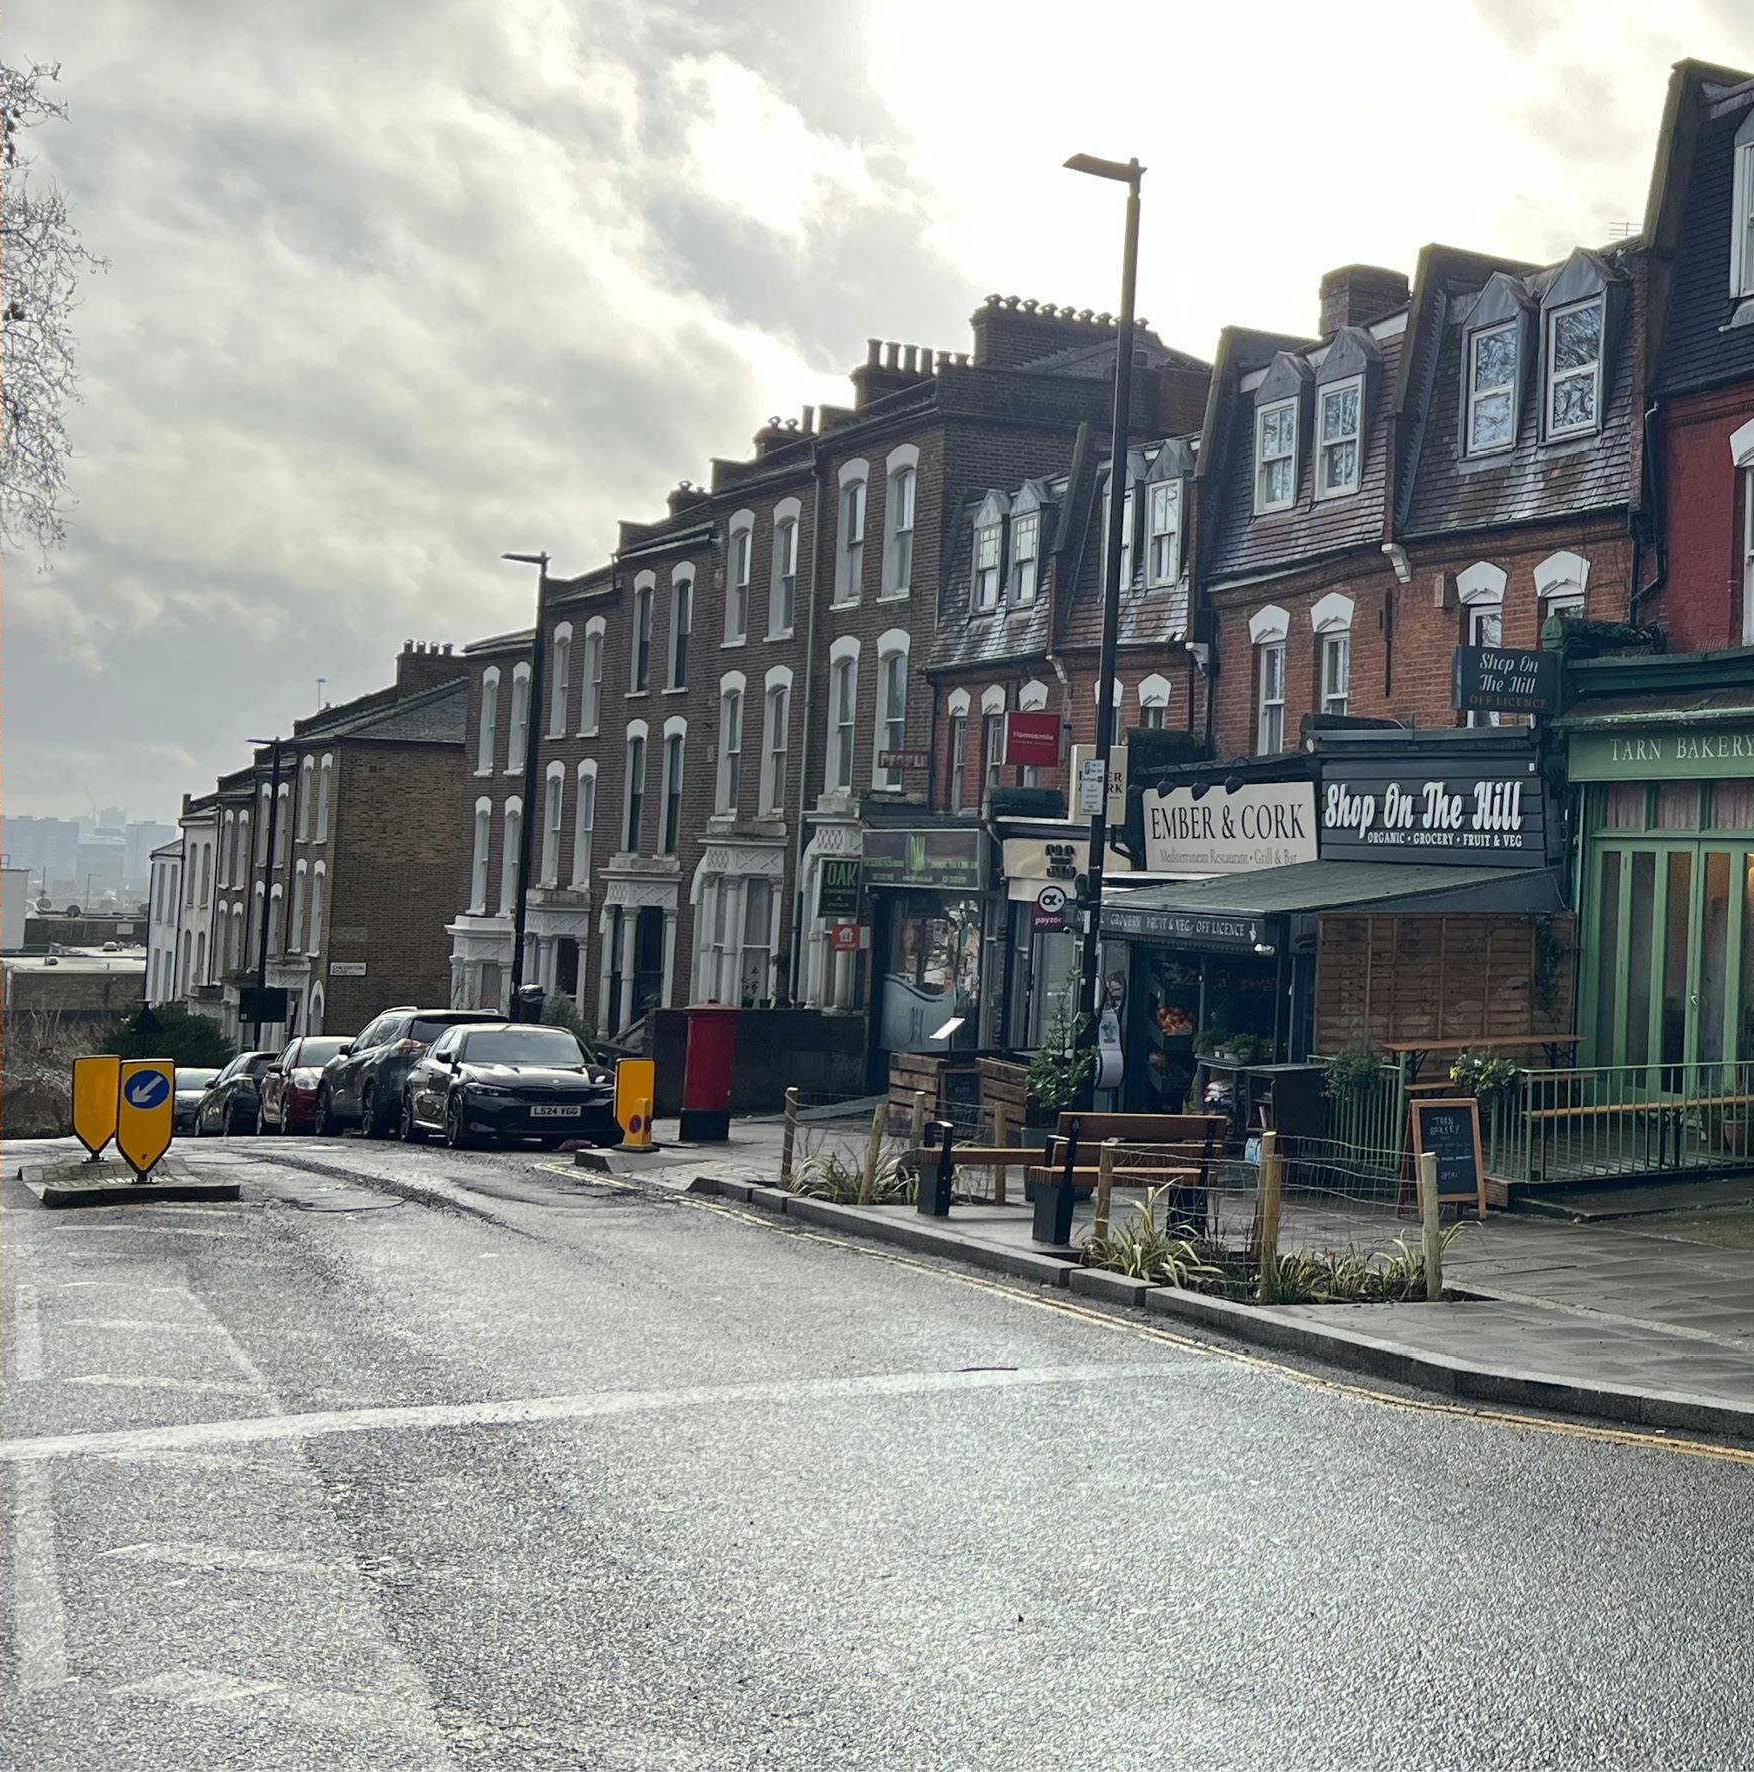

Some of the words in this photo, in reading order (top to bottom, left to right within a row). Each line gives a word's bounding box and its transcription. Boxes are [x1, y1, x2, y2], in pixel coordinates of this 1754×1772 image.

[1478, 652, 1515, 675] Shop
[1519, 655, 1540, 674] On
[1478, 674, 1504, 693] The
[1508, 675, 1536, 695] Hill
[1469, 694, 1492, 705] OFF
[1496, 698, 1547, 709] LICENCE
[1012, 730, 1054, 742] Homesmile
[880, 752, 928, 768] PEOPLE
[1610, 738, 1662, 761] TARN
[1324, 783, 1376, 839] Shop
[1384, 782, 1414, 828] On
[1422, 781, 1464, 830] The
[1472, 781, 1524, 830] Hill
[1150, 806, 1217, 840] EMBER
[1222, 804, 1236, 840] &
[1242, 804, 1306, 840] CORK
[1368, 832, 1405, 844] ORGANIC
[1413, 832, 1454, 845] GROCERY
[1463, 833, 1491, 847] FRUIT
[1494, 834, 1500, 847] &
[1502, 834, 1522, 848] VEG
[1254, 847, 1272, 865] Grill
[1274, 848, 1282, 864] &
[1284, 848, 1298, 865] Bar
[826, 862, 858, 886] OAK
[1110, 913, 1142, 929] GROCERY
[1146, 916, 1167, 932] FRUIT
[1176, 918, 1190, 932] VEG
[1196, 921, 1210, 934] OFF
[1212, 922, 1244, 937] LICENCE
